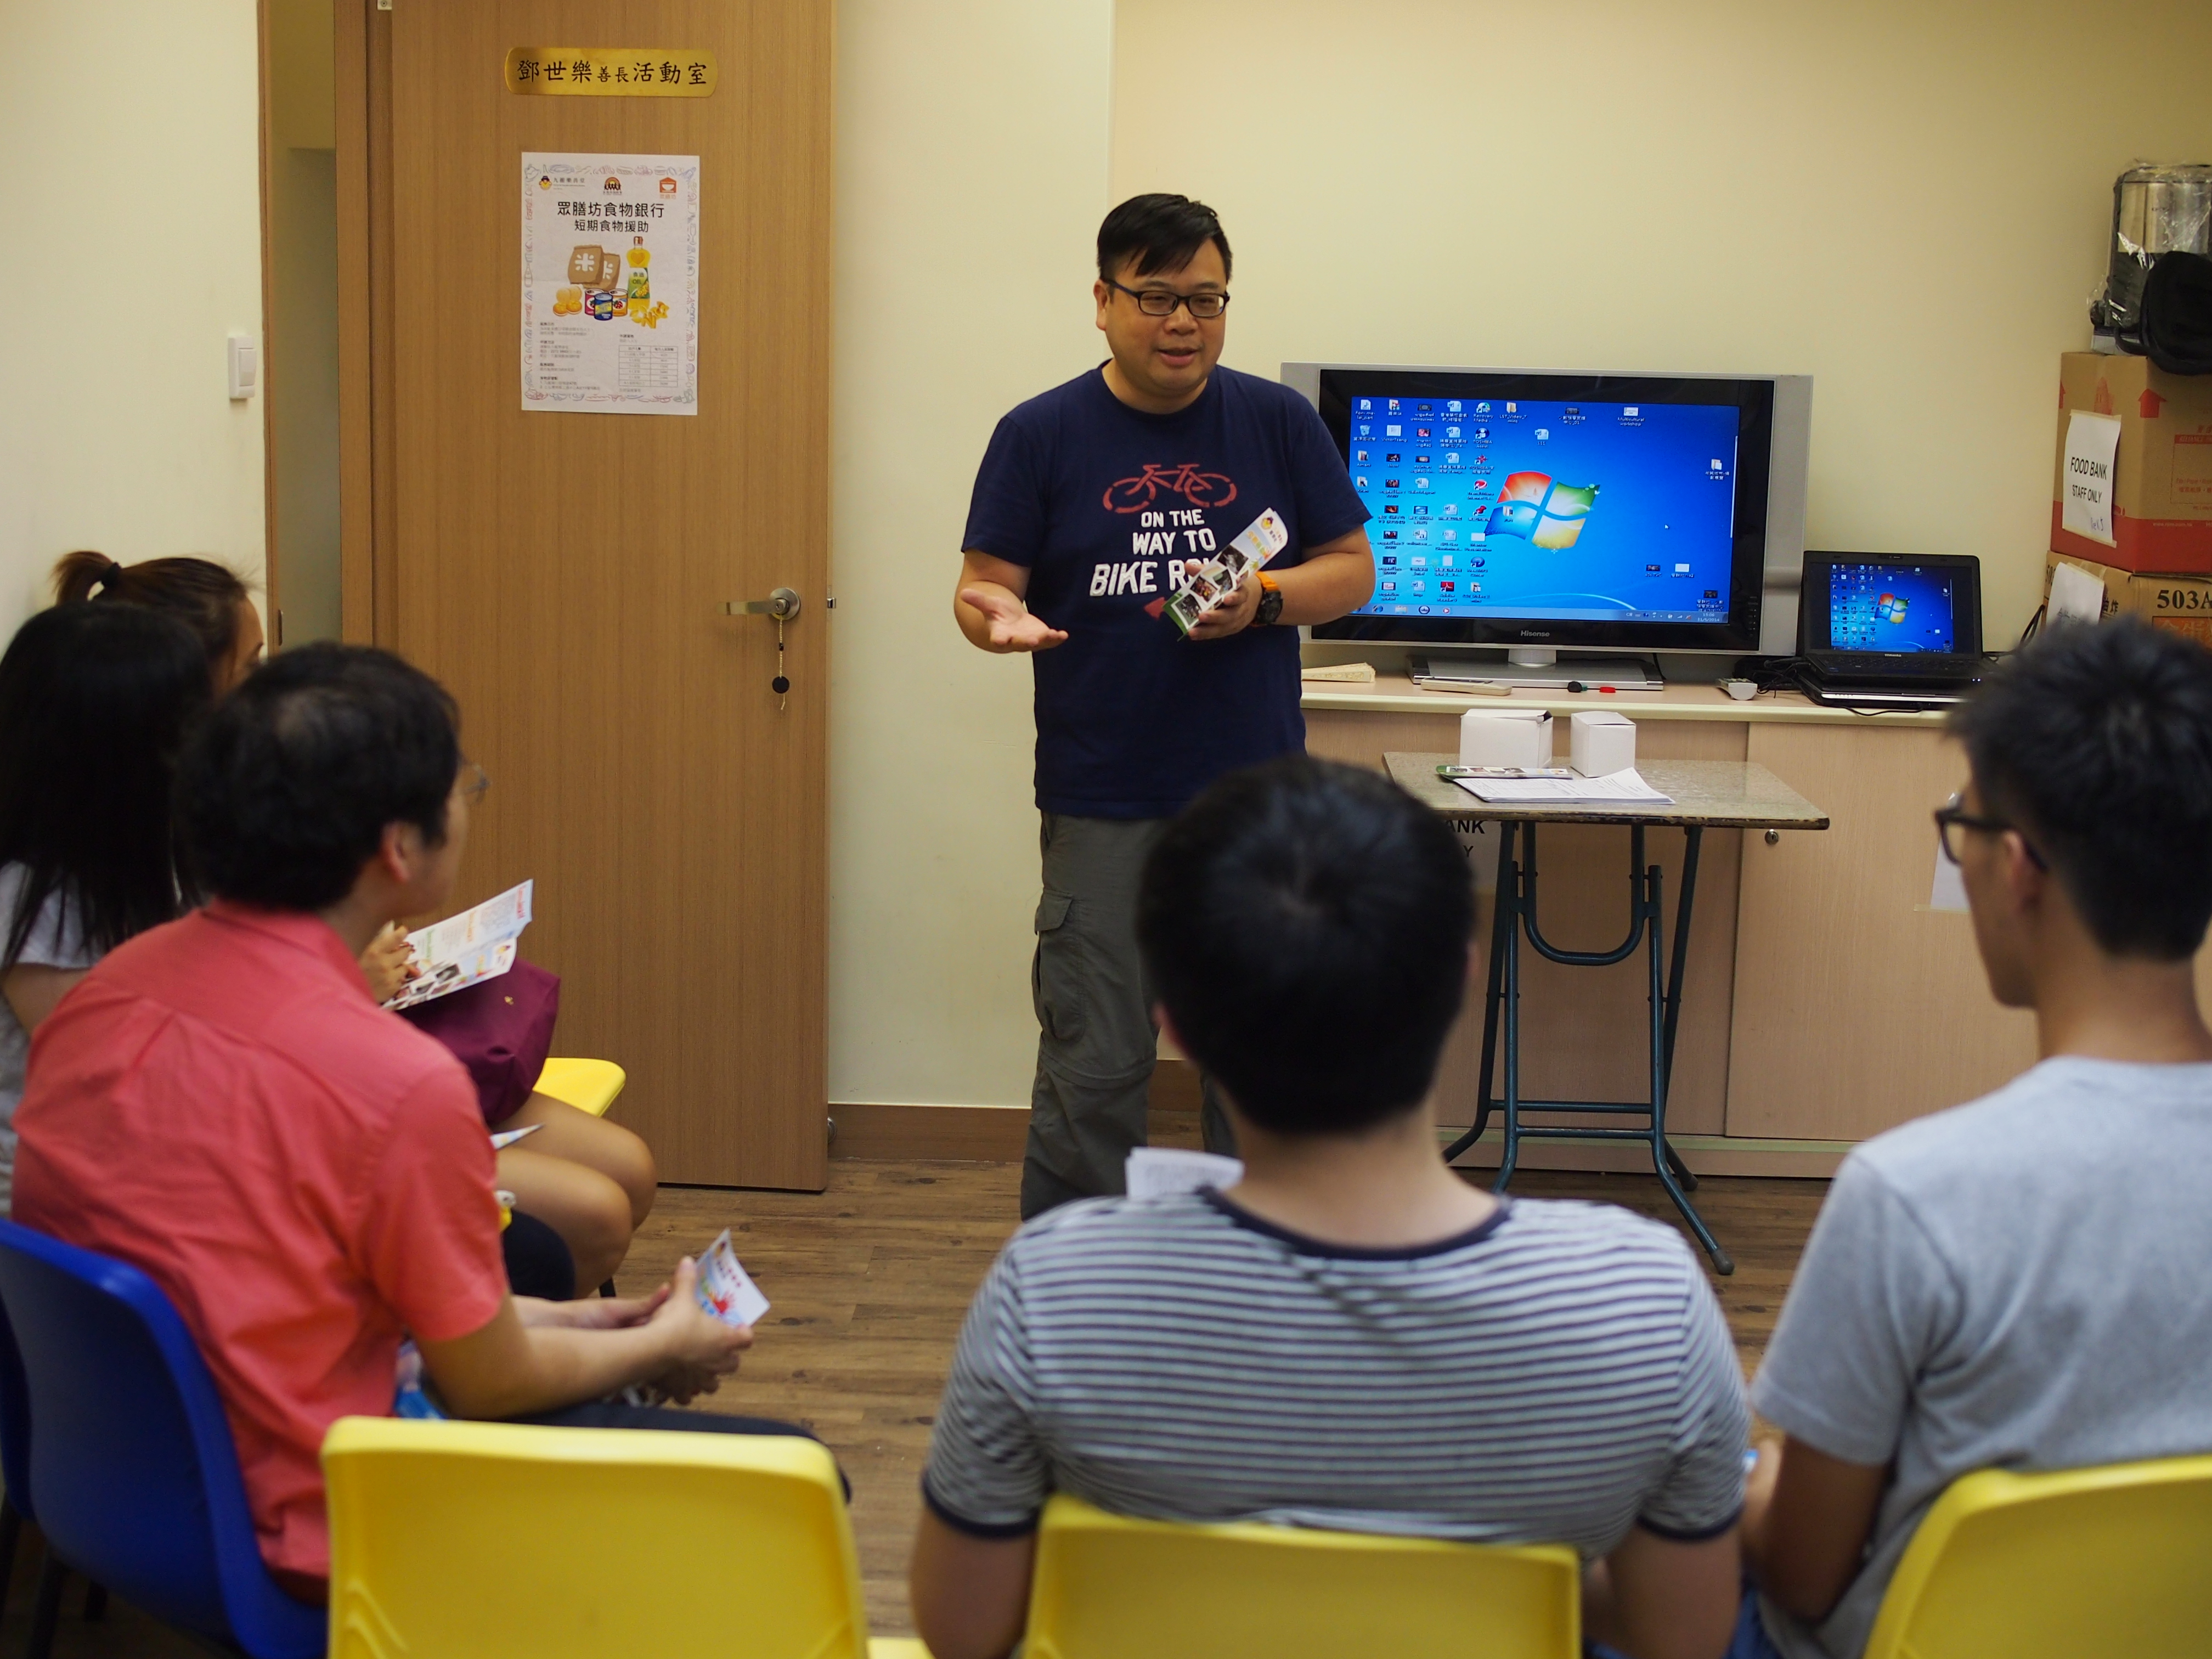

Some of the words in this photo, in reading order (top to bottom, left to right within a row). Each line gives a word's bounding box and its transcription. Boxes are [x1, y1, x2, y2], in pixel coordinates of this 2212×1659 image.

[517, 59, 707, 84] 鄧世樂善長活動室
[557, 201, 665, 218] 眾膳坊食物銀行
[574, 219, 649, 233] 短期食物援助
[2070, 456, 2089, 475] FOOD
[2090, 461, 2107, 481] BANK
[2072, 484, 2087, 500] STAFF
[2087, 489, 2102, 504] ONLY
[1141, 511, 1164, 528] ON
[1169, 509, 1205, 527] THE
[1132, 531, 1176, 556] WAY
[1183, 528, 1216, 552] TO
[1090, 561, 1158, 596] BIKE
[2157, 590, 2212, 609] 503A
[1445, 820, 1486, 834] ANK
